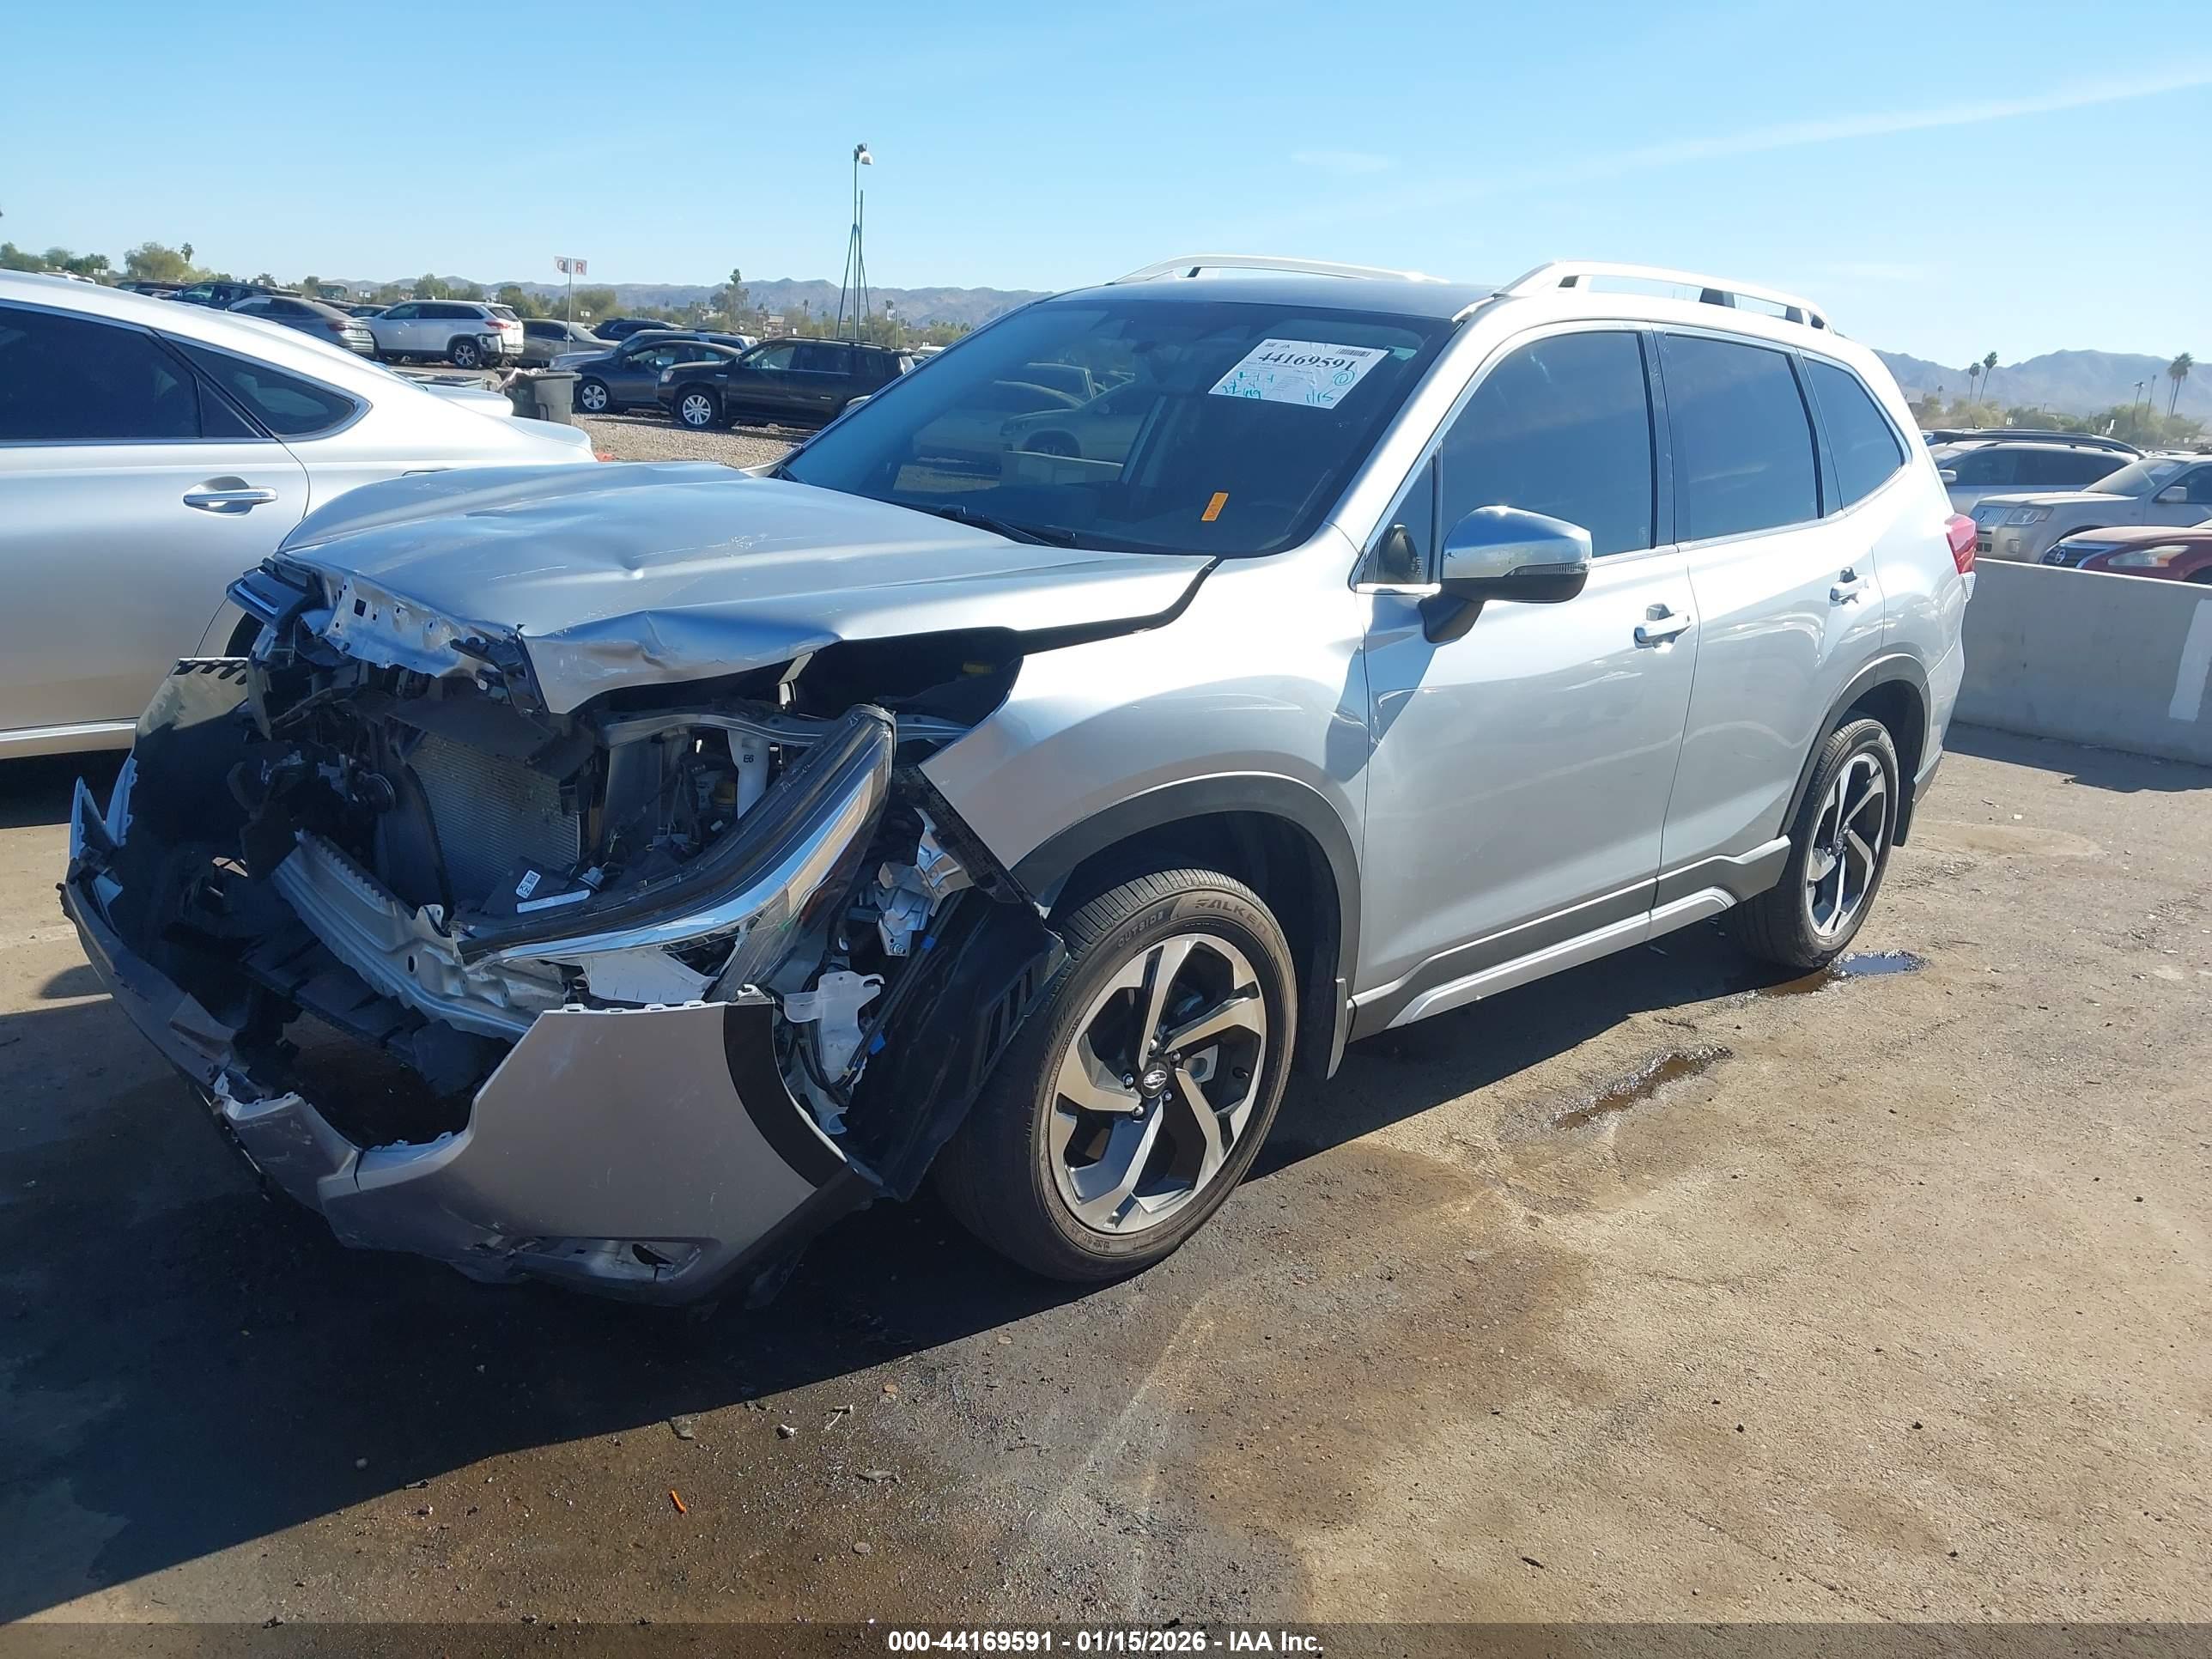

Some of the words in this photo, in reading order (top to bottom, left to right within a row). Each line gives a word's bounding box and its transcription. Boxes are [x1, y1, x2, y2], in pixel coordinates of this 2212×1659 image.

[575, 261, 584, 273] R
[1258, 351, 1357, 371] 44169591
[1117, 910, 1164, 948] OUTSIDE
